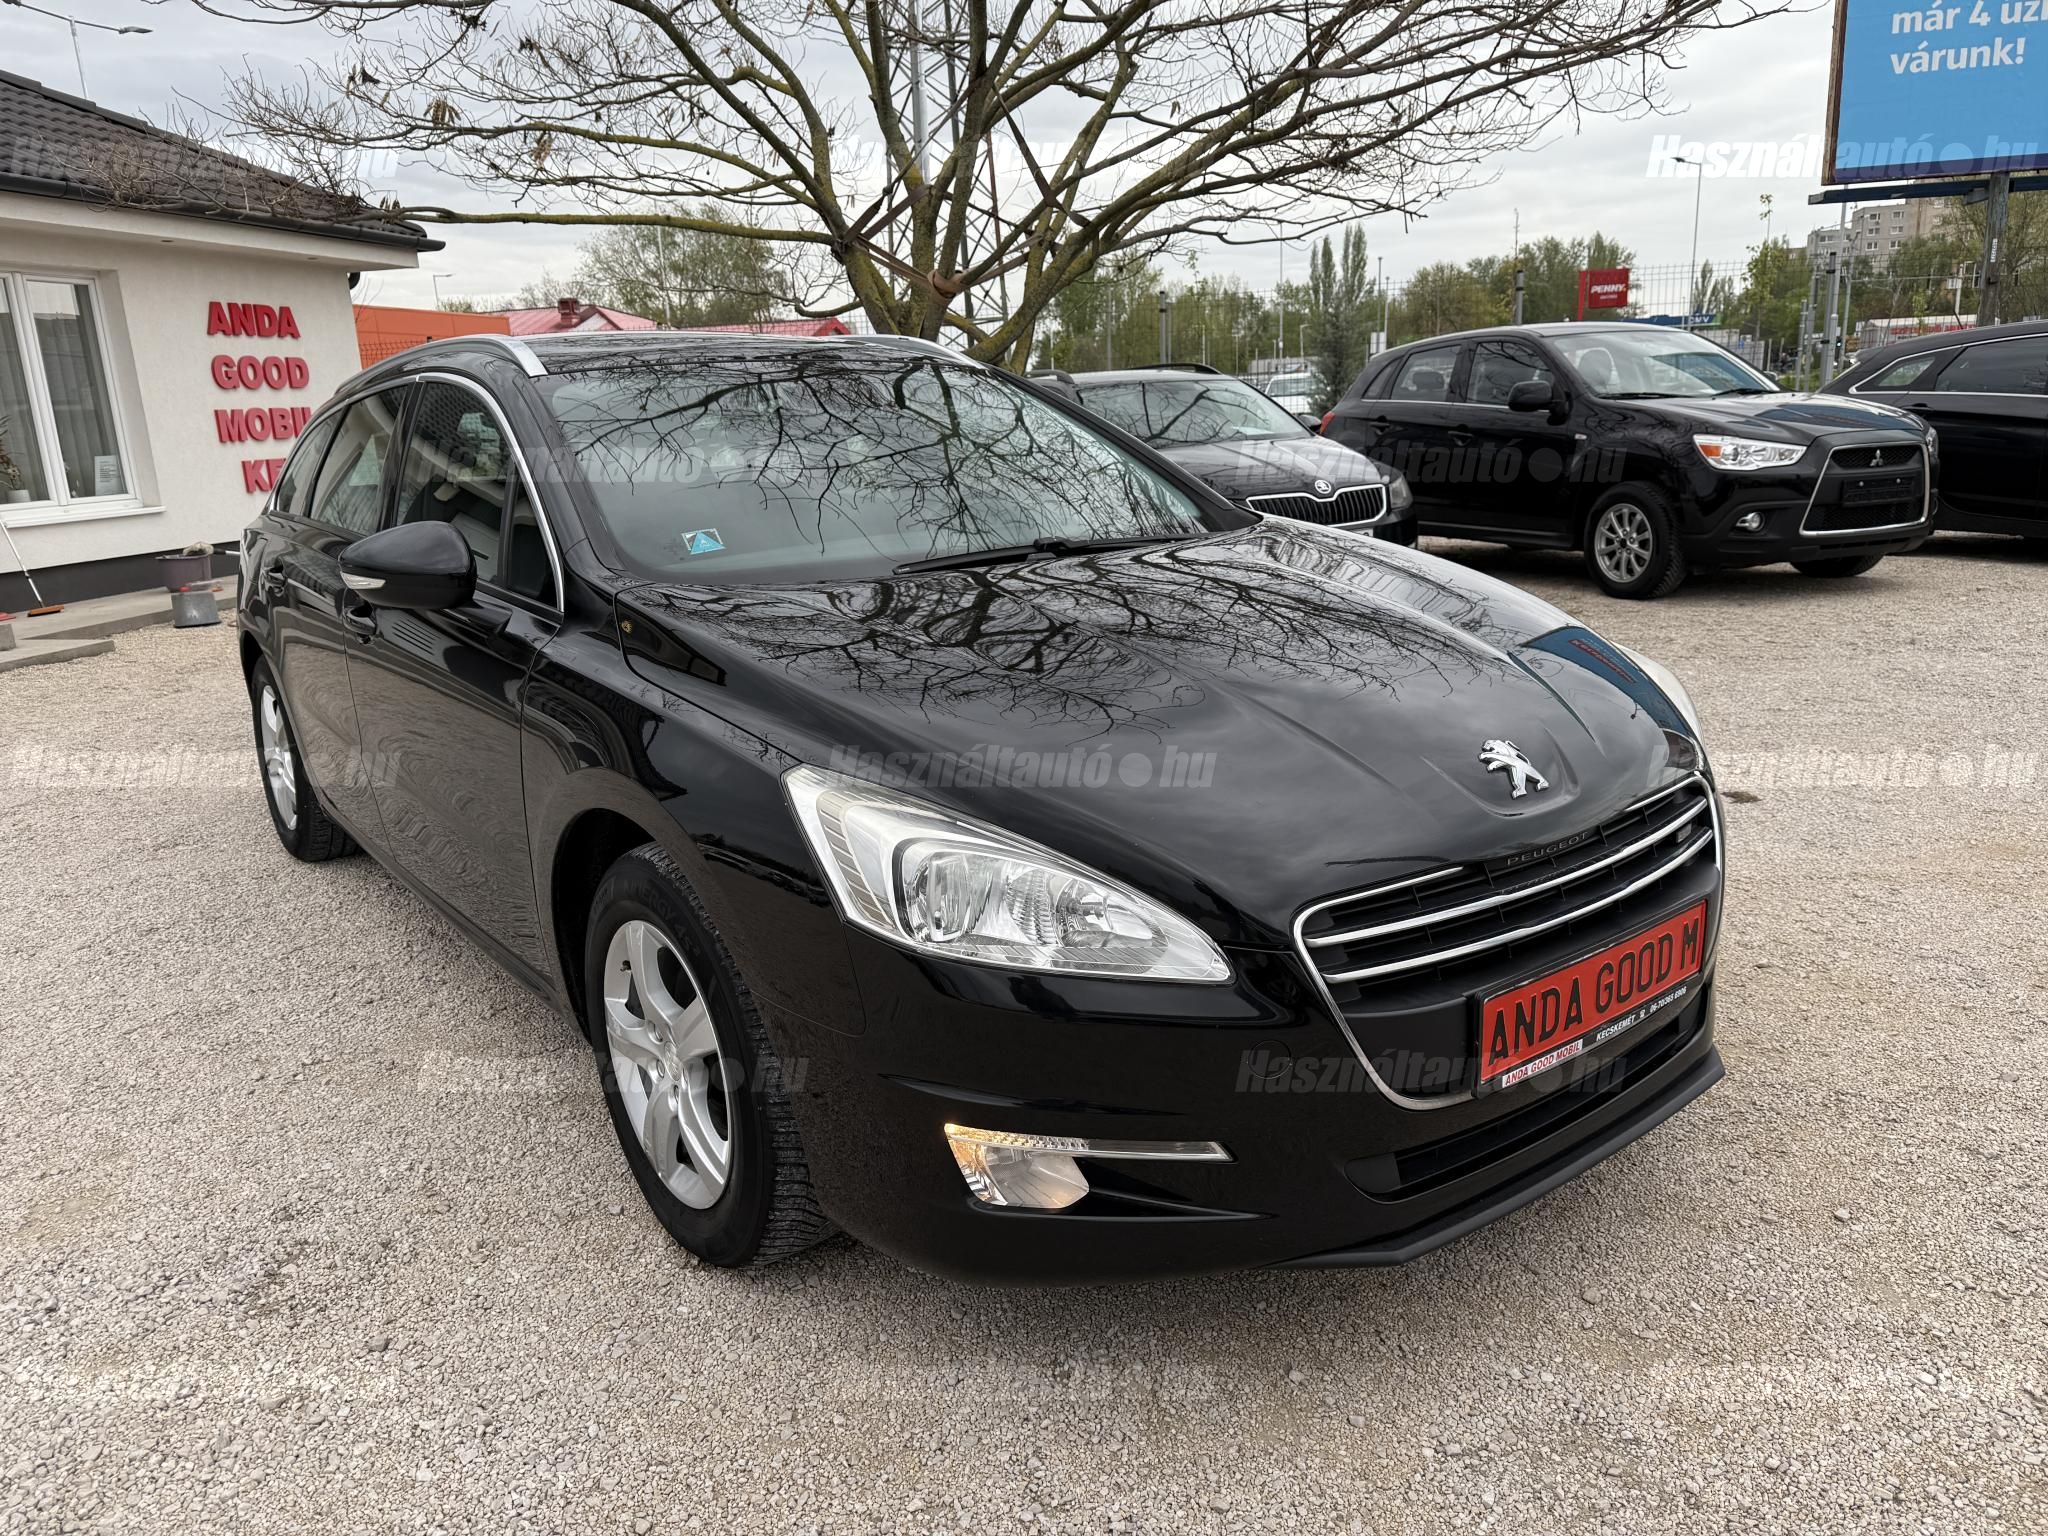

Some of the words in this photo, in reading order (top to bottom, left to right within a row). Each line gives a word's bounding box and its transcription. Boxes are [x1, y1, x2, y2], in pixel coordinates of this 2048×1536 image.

[1891, 0, 1961, 34] már
[1968, 0, 1991, 27] 4
[1890, 37, 2026, 74] várunk!
[207, 301, 301, 340] ANDA
[211, 354, 309, 390] GOOD
[1507, 831, 1589, 866] PEUGEOT
[1488, 977, 1583, 1066] ANDA
[1595, 932, 1674, 1014] GOOD
[1680, 917, 1699, 970] M
[1505, 1068, 1529, 1086] ANDA
[1530, 1056, 1554, 1073] GOOD
[1555, 1042, 1581, 1061] MOBIL
[1596, 1013, 1636, 1042] KECSKEMÉT
